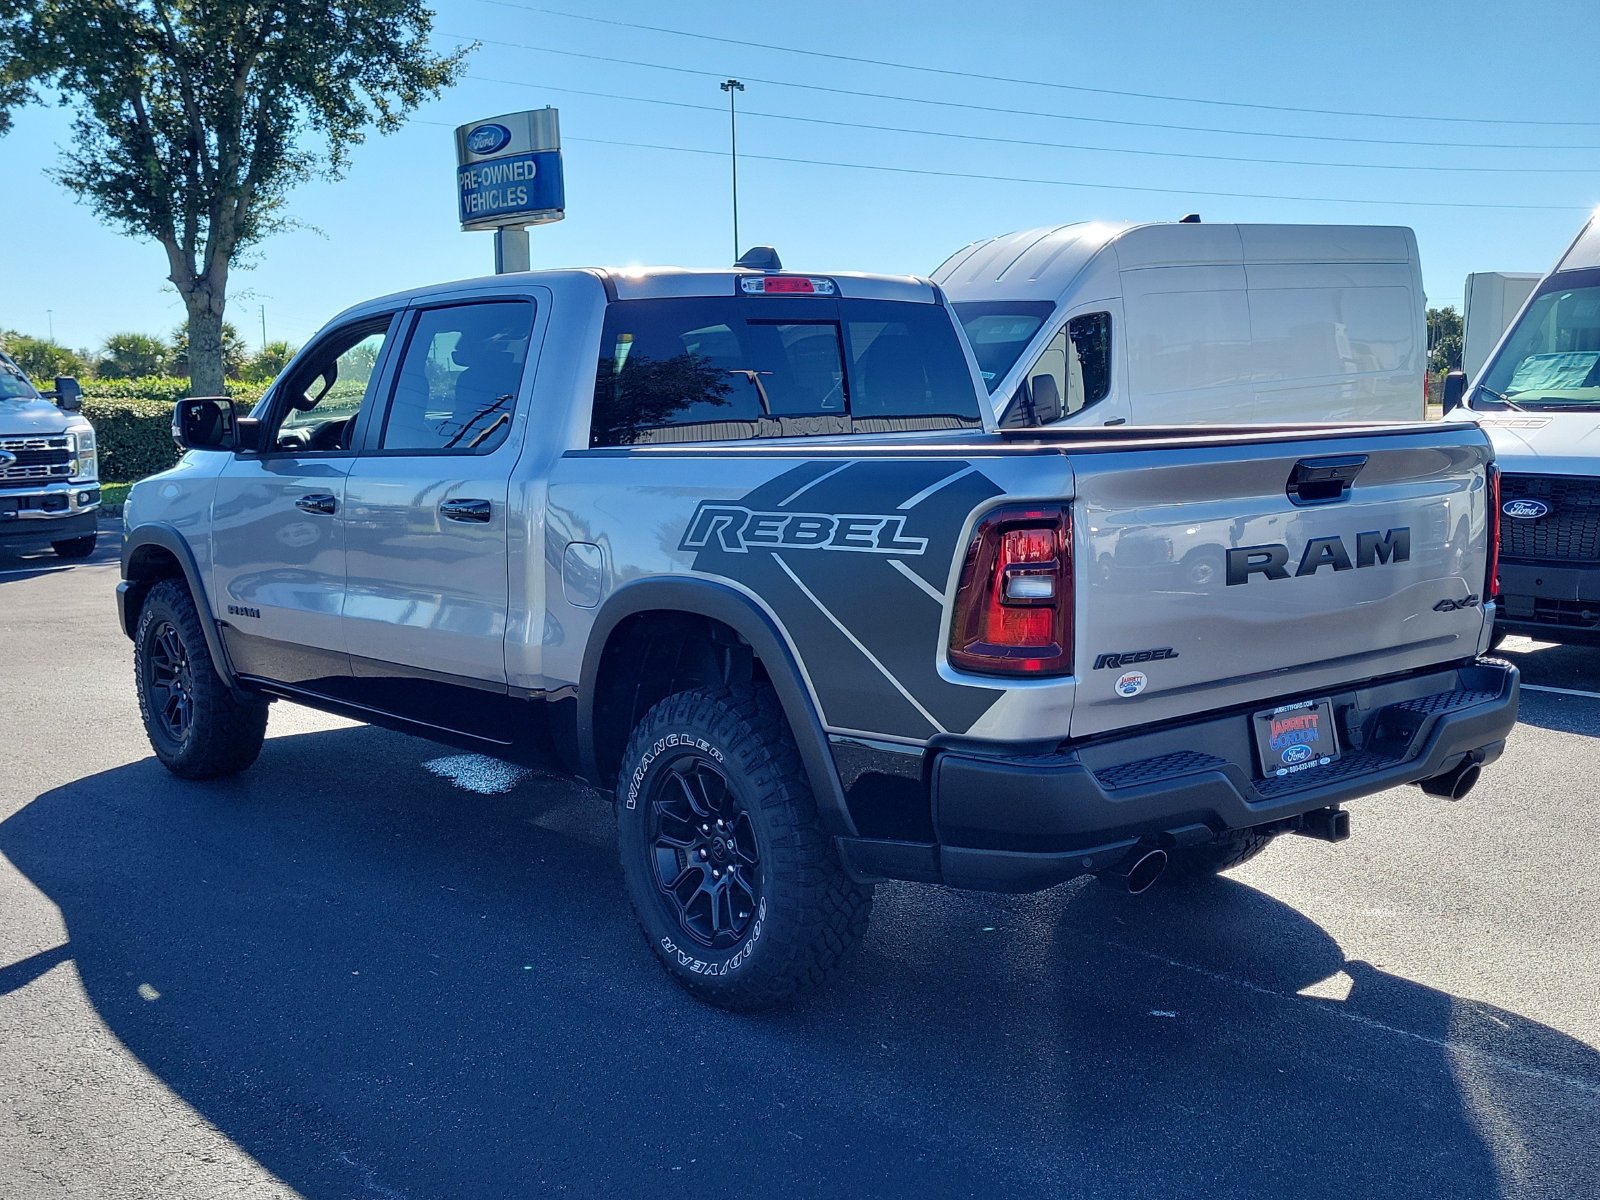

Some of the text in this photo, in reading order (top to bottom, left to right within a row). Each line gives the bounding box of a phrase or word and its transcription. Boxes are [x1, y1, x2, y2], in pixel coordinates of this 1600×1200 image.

[473, 131, 495, 150] Ford
[460, 160, 537, 191] PRE-OWNED
[464, 186, 528, 214] VEHICLES
[1510, 502, 1539, 516] Ford
[683, 504, 929, 555] REBEL
[1225, 526, 1411, 587] RAM
[1092, 647, 1180, 670] REBEL
[1268, 728, 1320, 752] GORDON
[1270, 714, 1319, 744] JARRETT
[626, 733, 725, 810] WRANGLER
[661, 896, 767, 976] GOODYEAR
